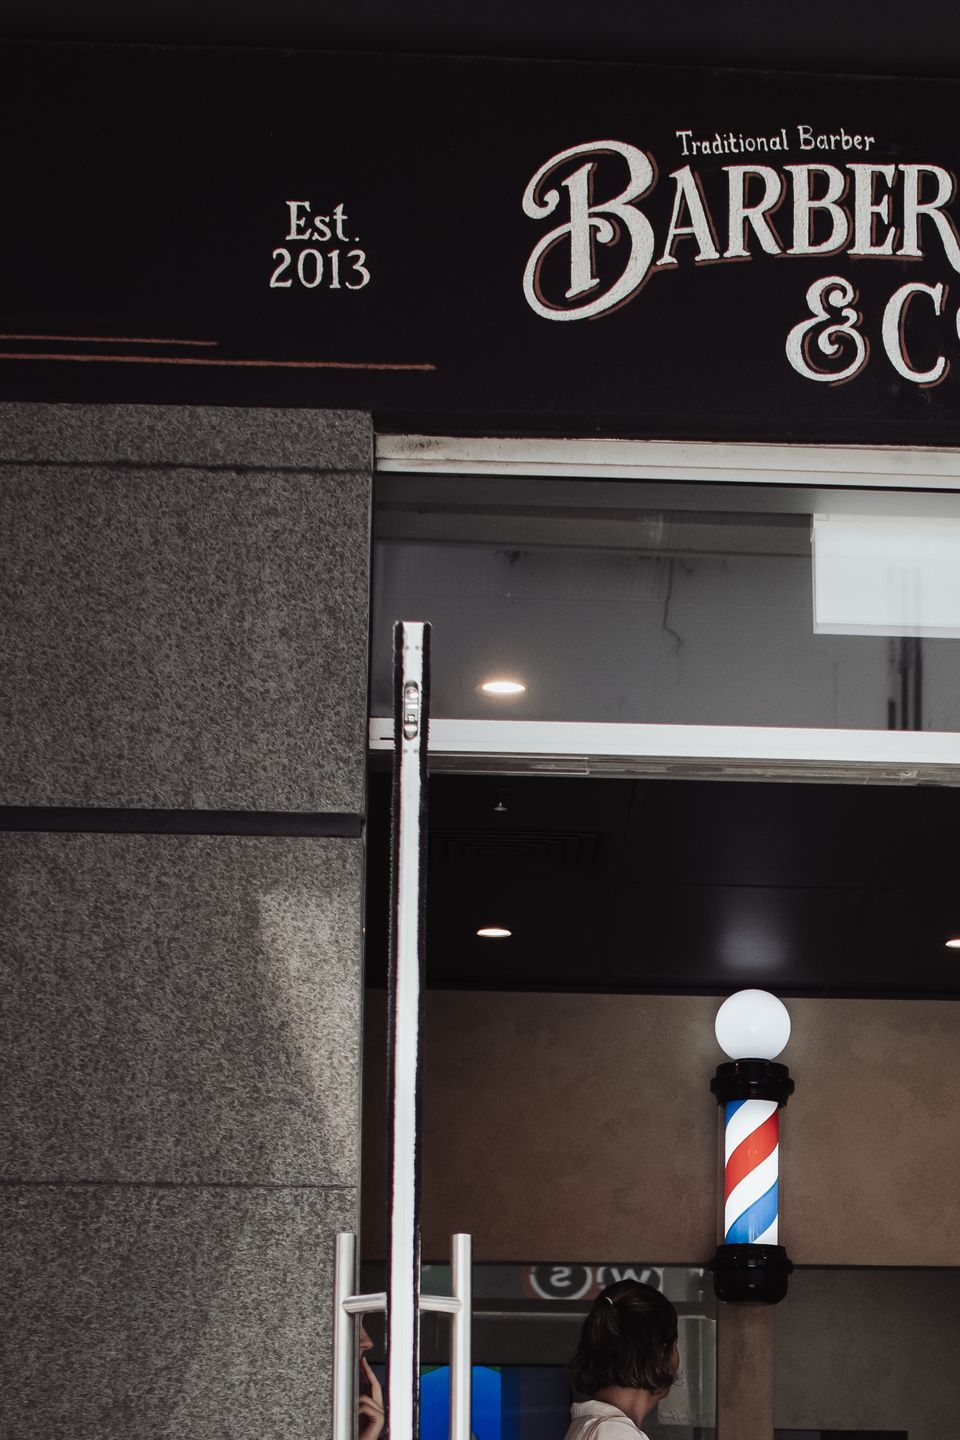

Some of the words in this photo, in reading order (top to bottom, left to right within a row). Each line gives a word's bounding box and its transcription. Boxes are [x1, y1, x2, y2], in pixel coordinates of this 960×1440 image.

[675, 128, 789, 156] Traditional
[797, 125, 875, 150] Barber
[285, 201, 360, 242] Est.
[269, 247, 371, 290] 2013
[785, 275, 866, 382] &
